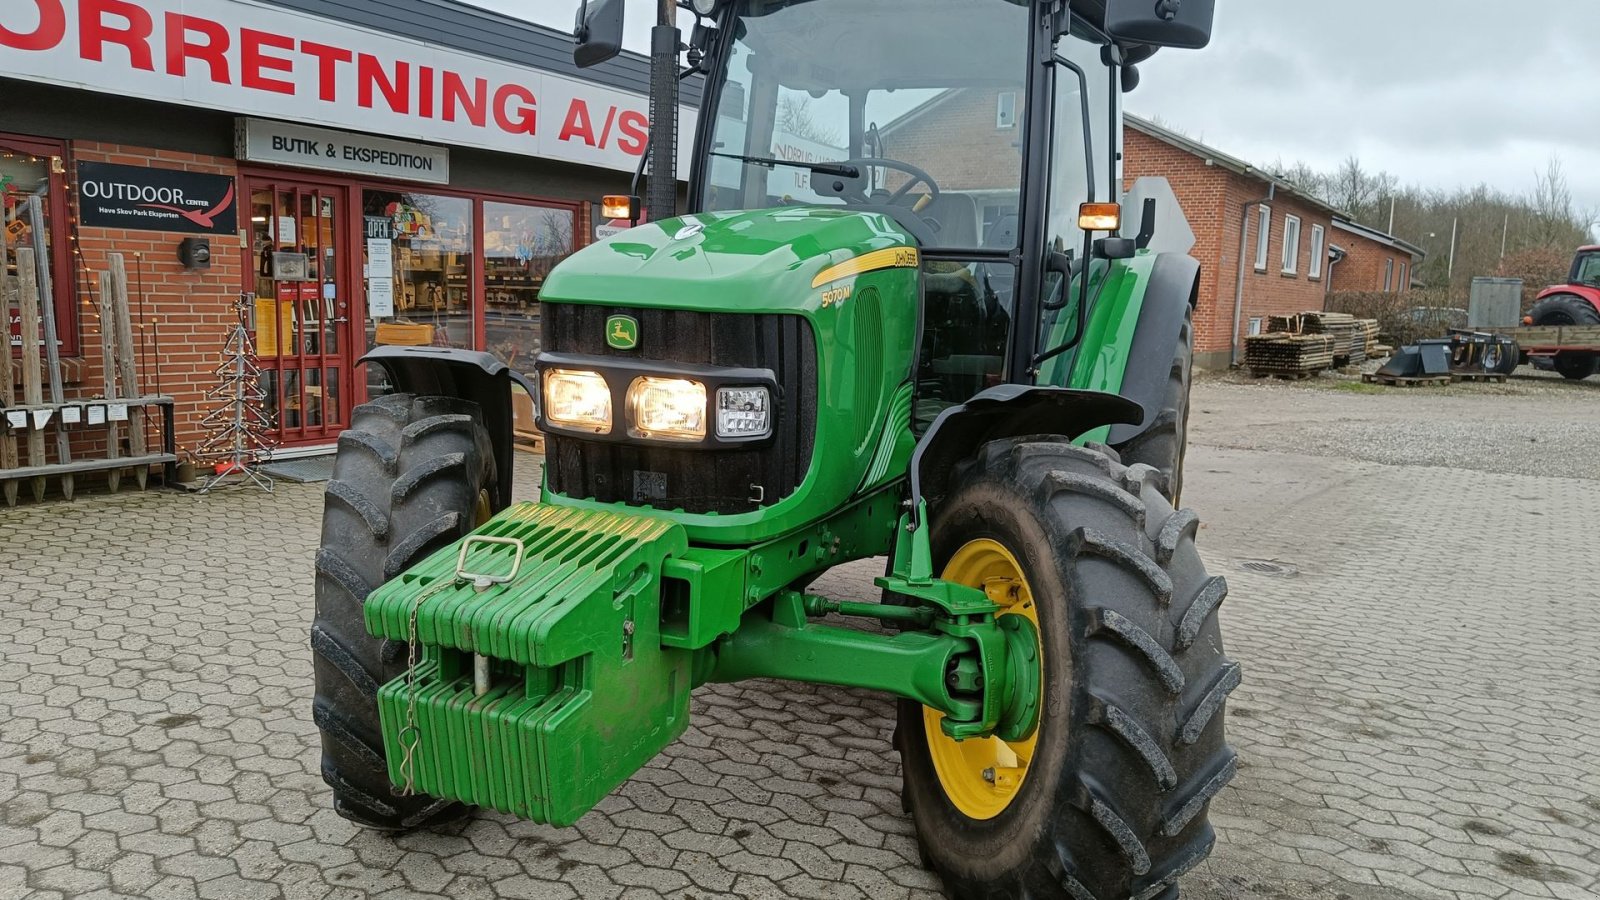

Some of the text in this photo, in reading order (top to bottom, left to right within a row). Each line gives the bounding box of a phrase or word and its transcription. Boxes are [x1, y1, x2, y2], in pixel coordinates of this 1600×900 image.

[558, 98, 649, 156] A/S
[272, 135, 432, 171] BUTIK & EKSPEDITION
[82, 180, 209, 207] OUTDOOR CENTER
[99, 206, 179, 220] Have Skov Park Eksperten
[368, 221, 388, 238] OPEN
[821, 286, 850, 308] 5070M
